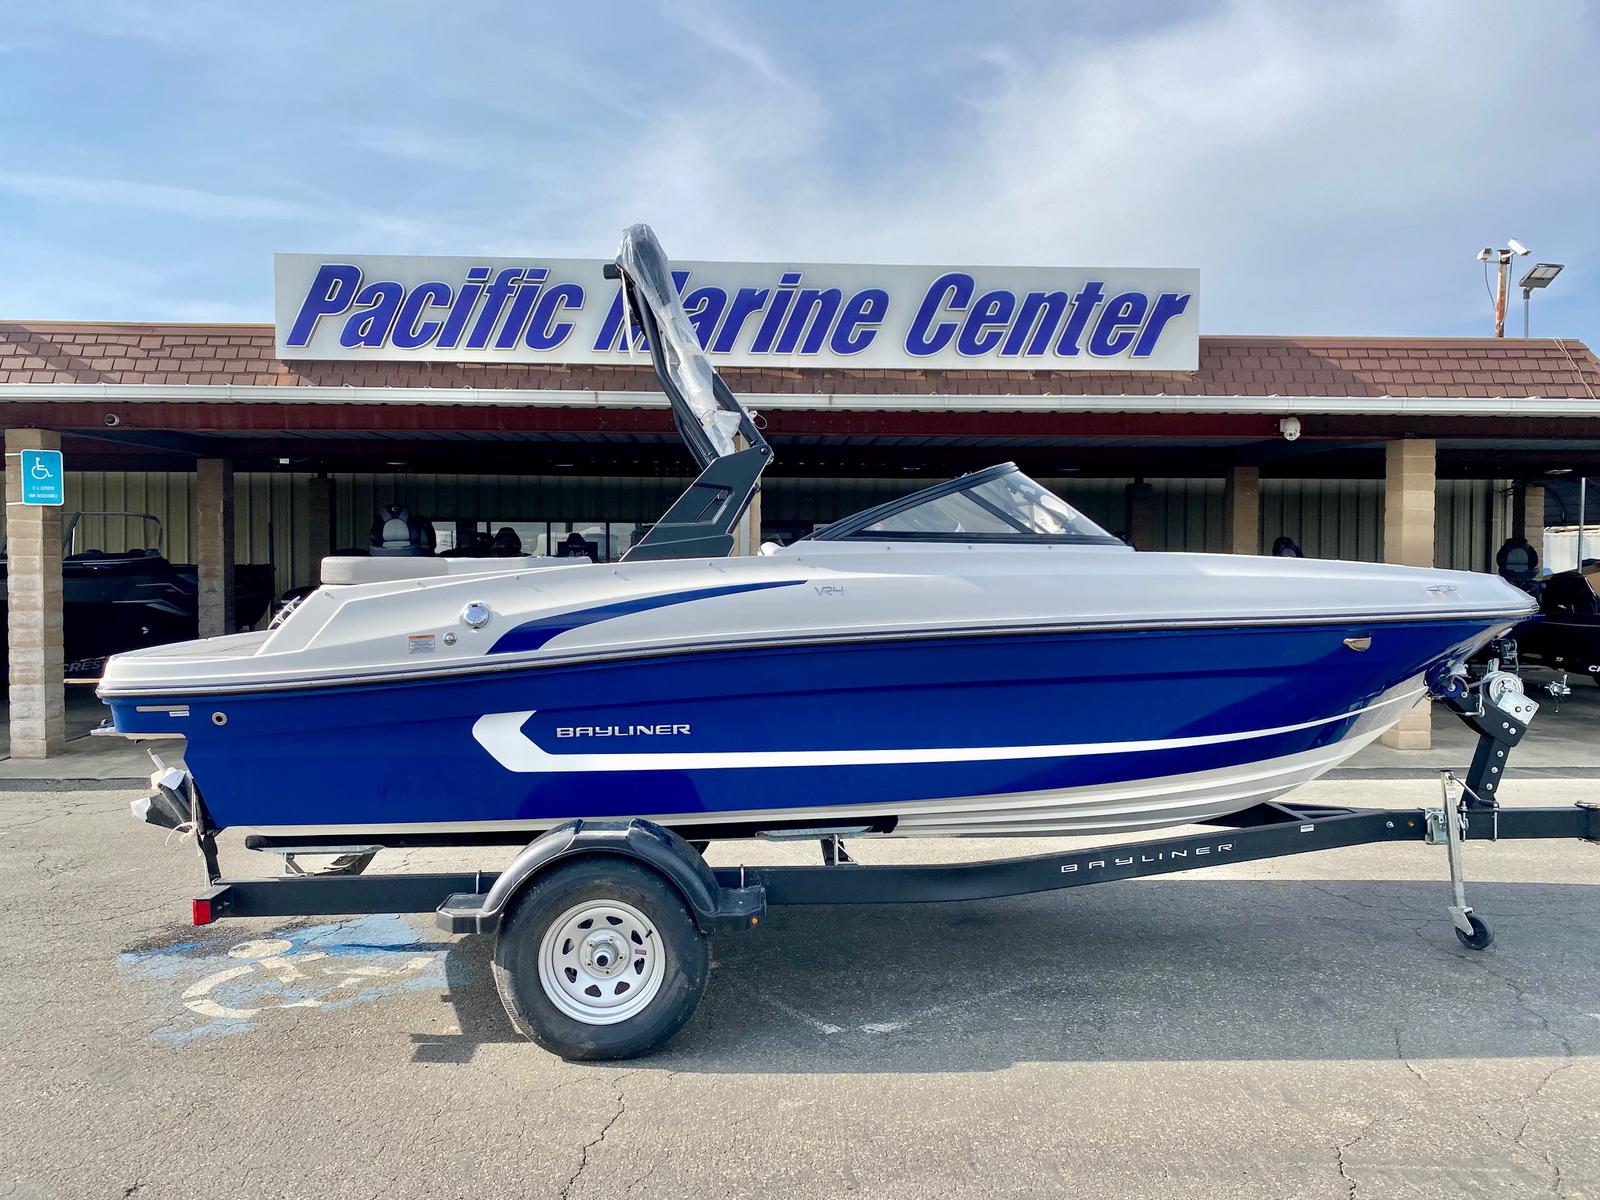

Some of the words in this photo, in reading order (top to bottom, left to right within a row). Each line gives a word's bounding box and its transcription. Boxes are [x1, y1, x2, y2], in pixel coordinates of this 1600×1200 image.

[284, 263, 586, 351] Pacific
[903, 272, 1193, 358] Center
[556, 724, 691, 738] BAYLINER
[1061, 843, 1233, 873] BAYLINER
